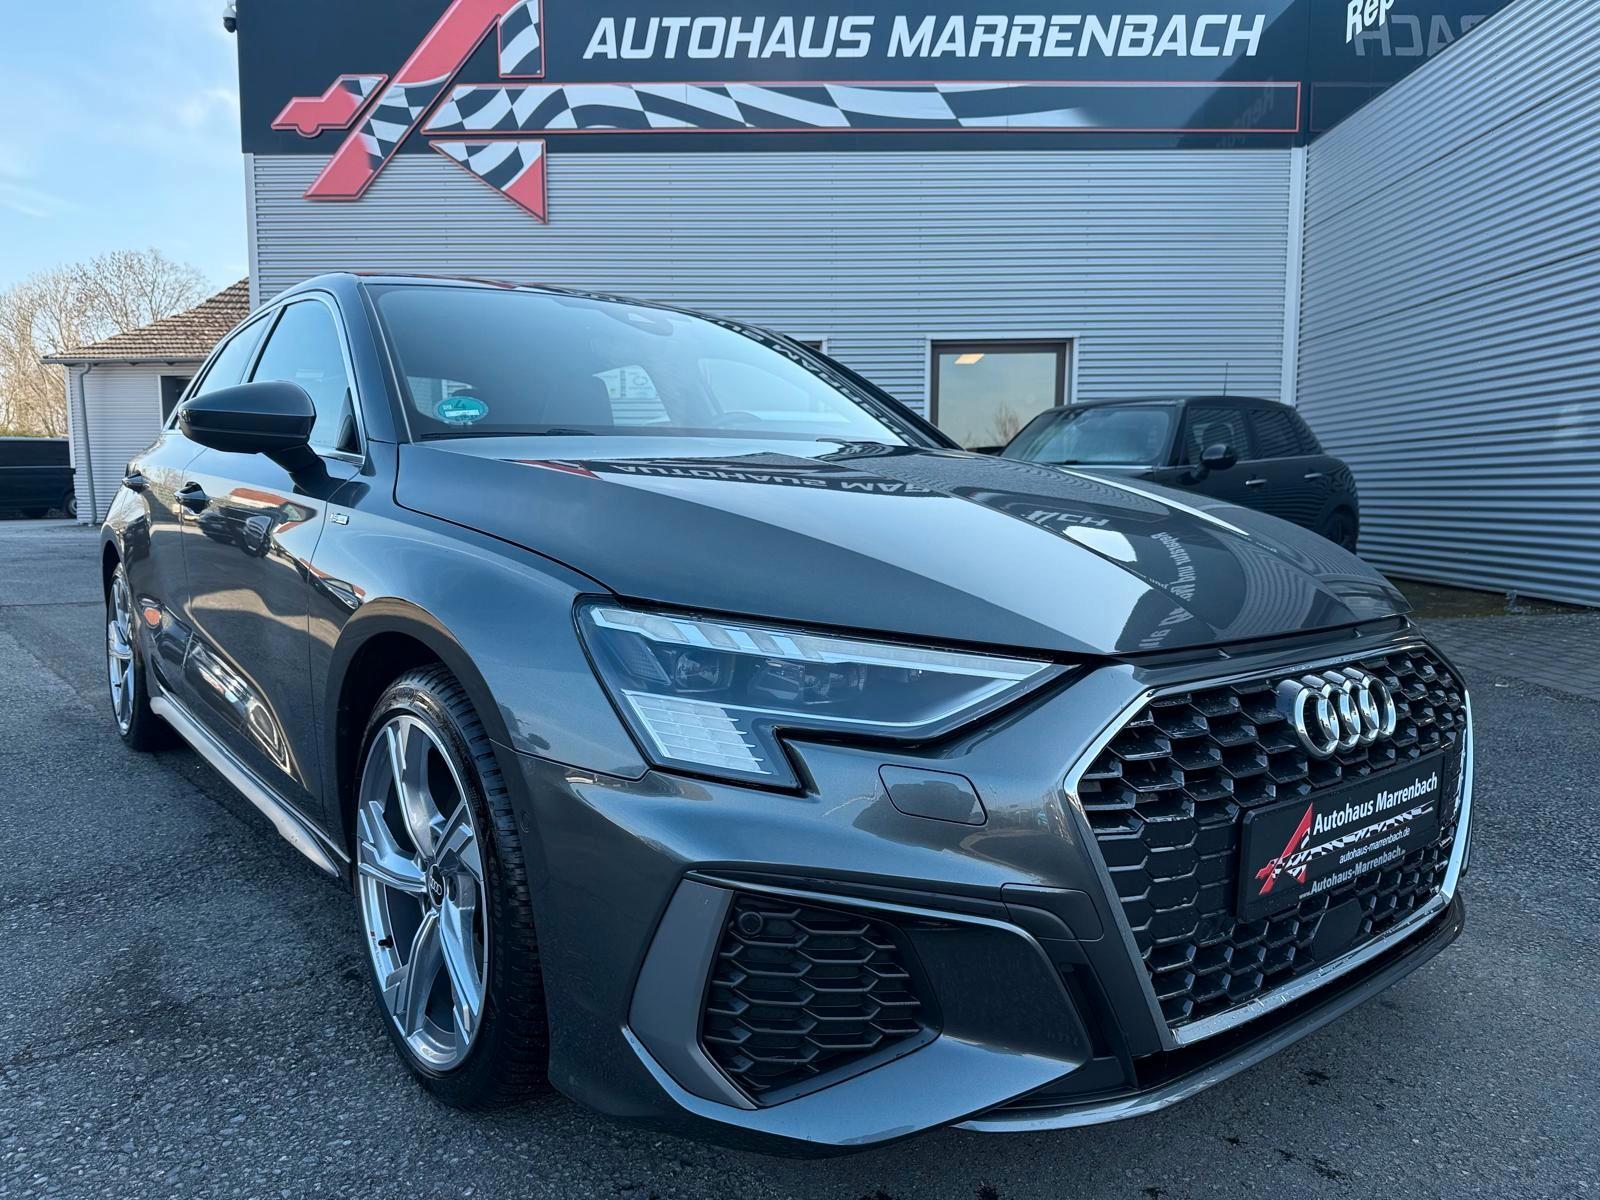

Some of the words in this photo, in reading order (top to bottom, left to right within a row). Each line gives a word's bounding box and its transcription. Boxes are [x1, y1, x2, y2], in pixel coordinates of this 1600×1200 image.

[583, 15, 875, 59] AUTOHAUS
[886, 14, 1266, 58] MARRENBACH
[1313, 800, 1374, 836] Autohaus
[1375, 771, 1438, 813] Marrenbach
[1339, 826, 1411, 865] autohaus-marrenbach.de
